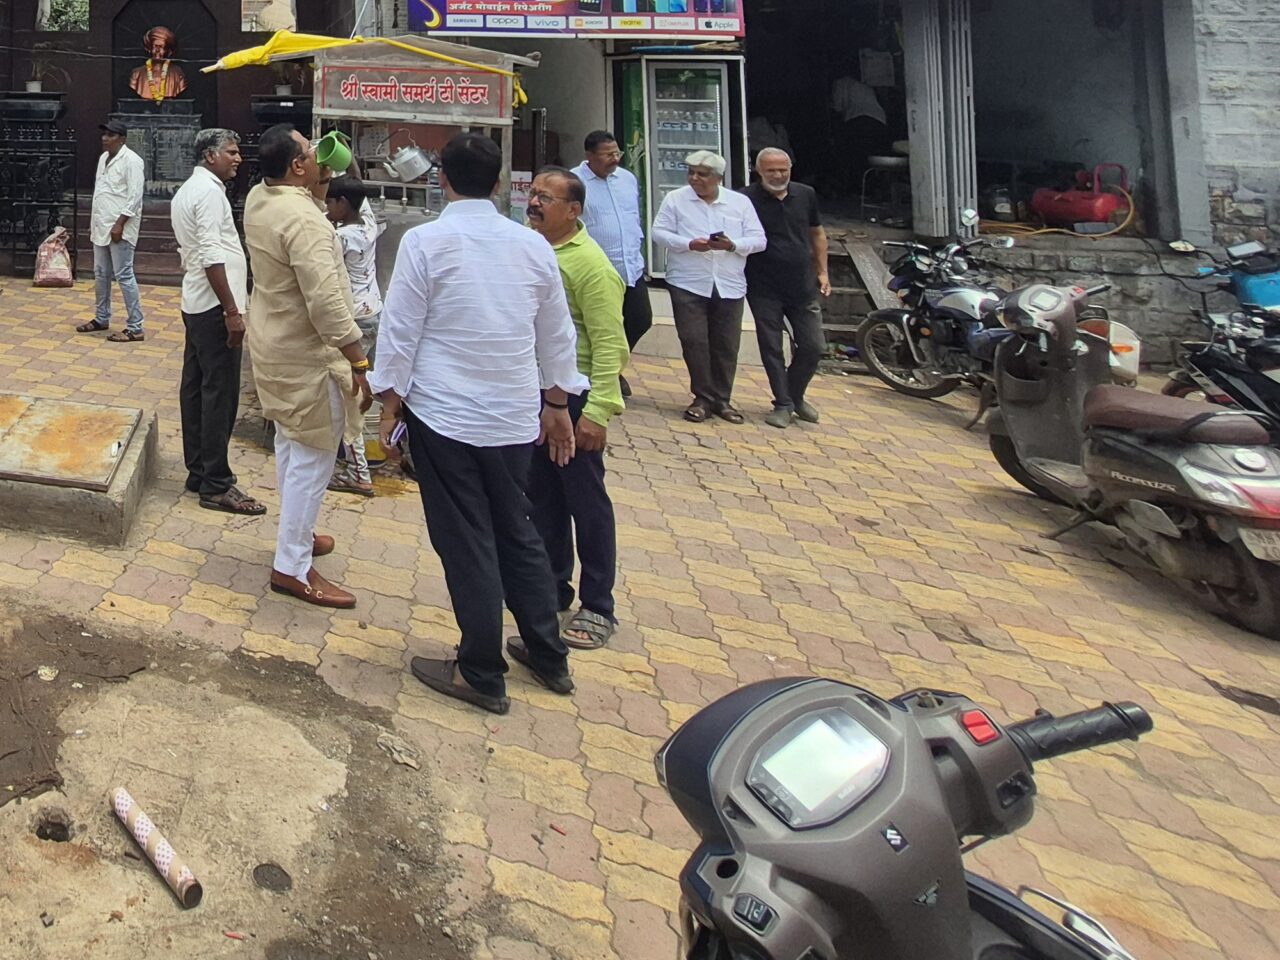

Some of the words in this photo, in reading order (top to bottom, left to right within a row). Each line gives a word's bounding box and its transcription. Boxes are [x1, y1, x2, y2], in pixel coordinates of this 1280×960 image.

[476, 0, 510, 12] मोबाईल
[714, 20, 734, 29] Apple
[340, 74, 359, 100] श्री
[361, 76, 399, 102] स्वामी
[401, 77, 436, 103] समर्थ
[438, 77, 455, 103] टी
[457, 77, 489, 104] सेंटर
